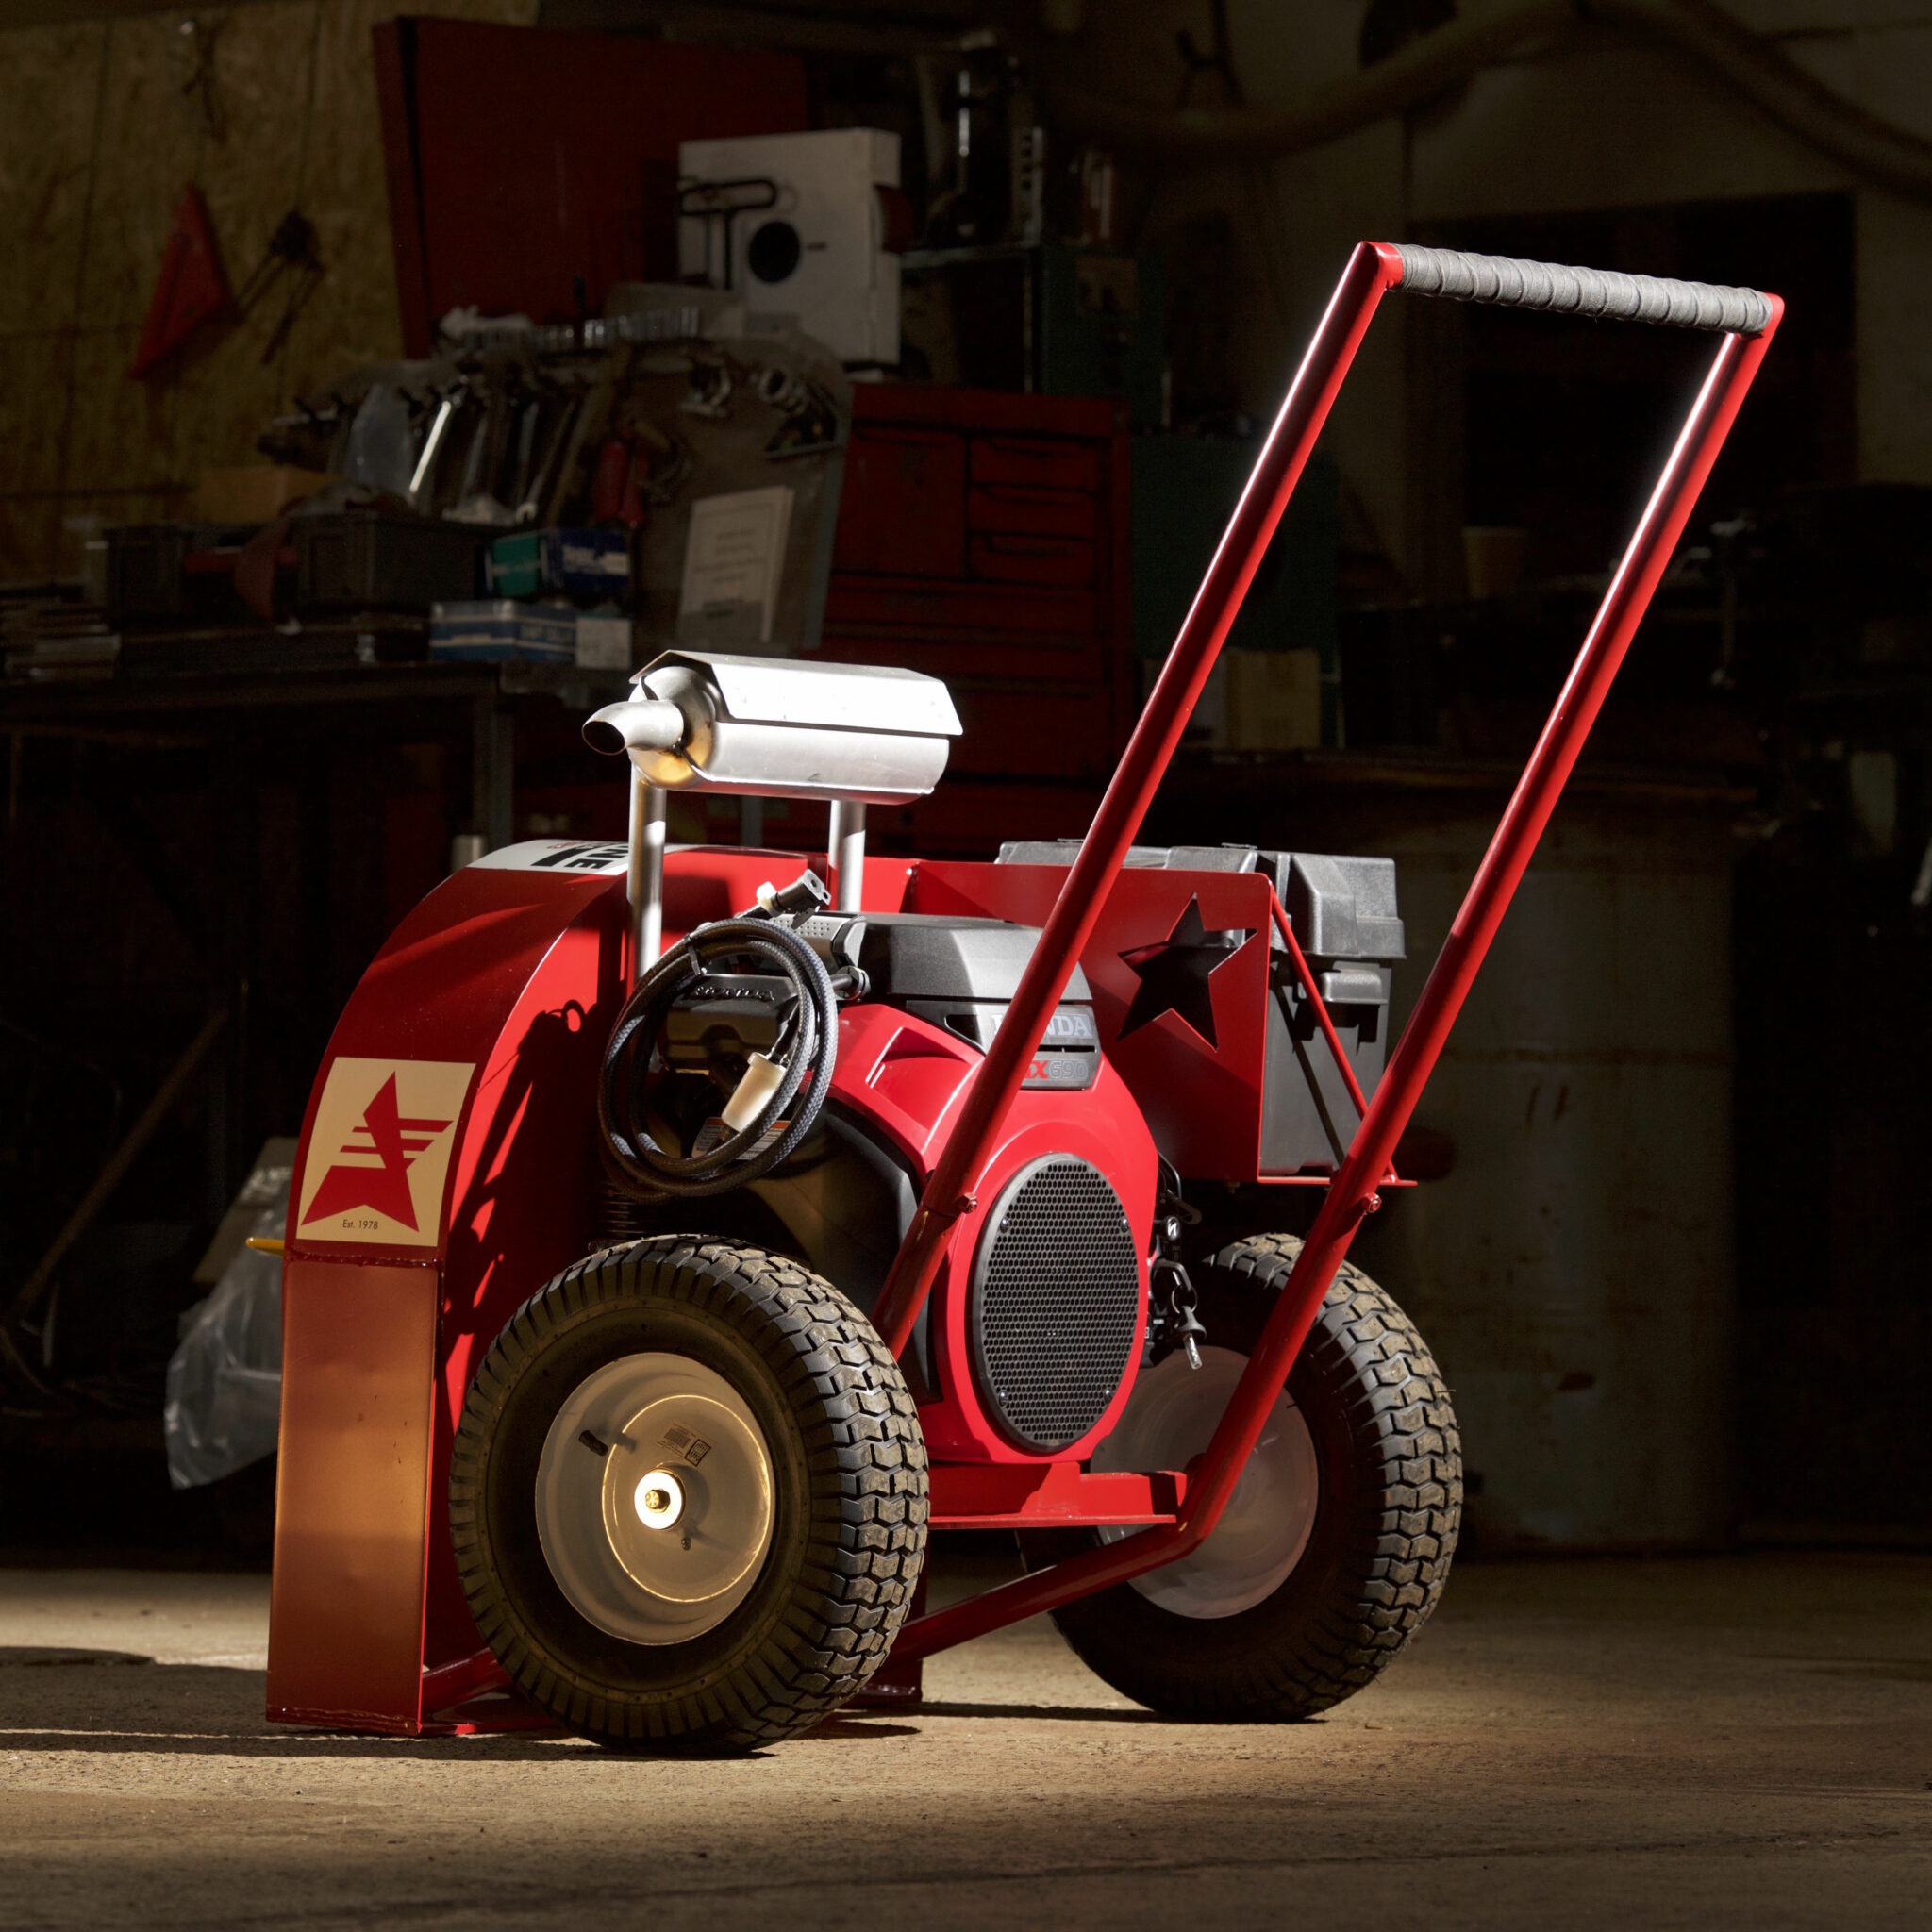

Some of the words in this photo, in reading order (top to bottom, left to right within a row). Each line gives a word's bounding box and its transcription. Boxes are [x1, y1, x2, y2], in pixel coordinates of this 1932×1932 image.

[991, 1015, 1091, 1038] NDA
[342, 1219, 356, 1229] Est.
[358, 1221, 379, 1230] 1978
